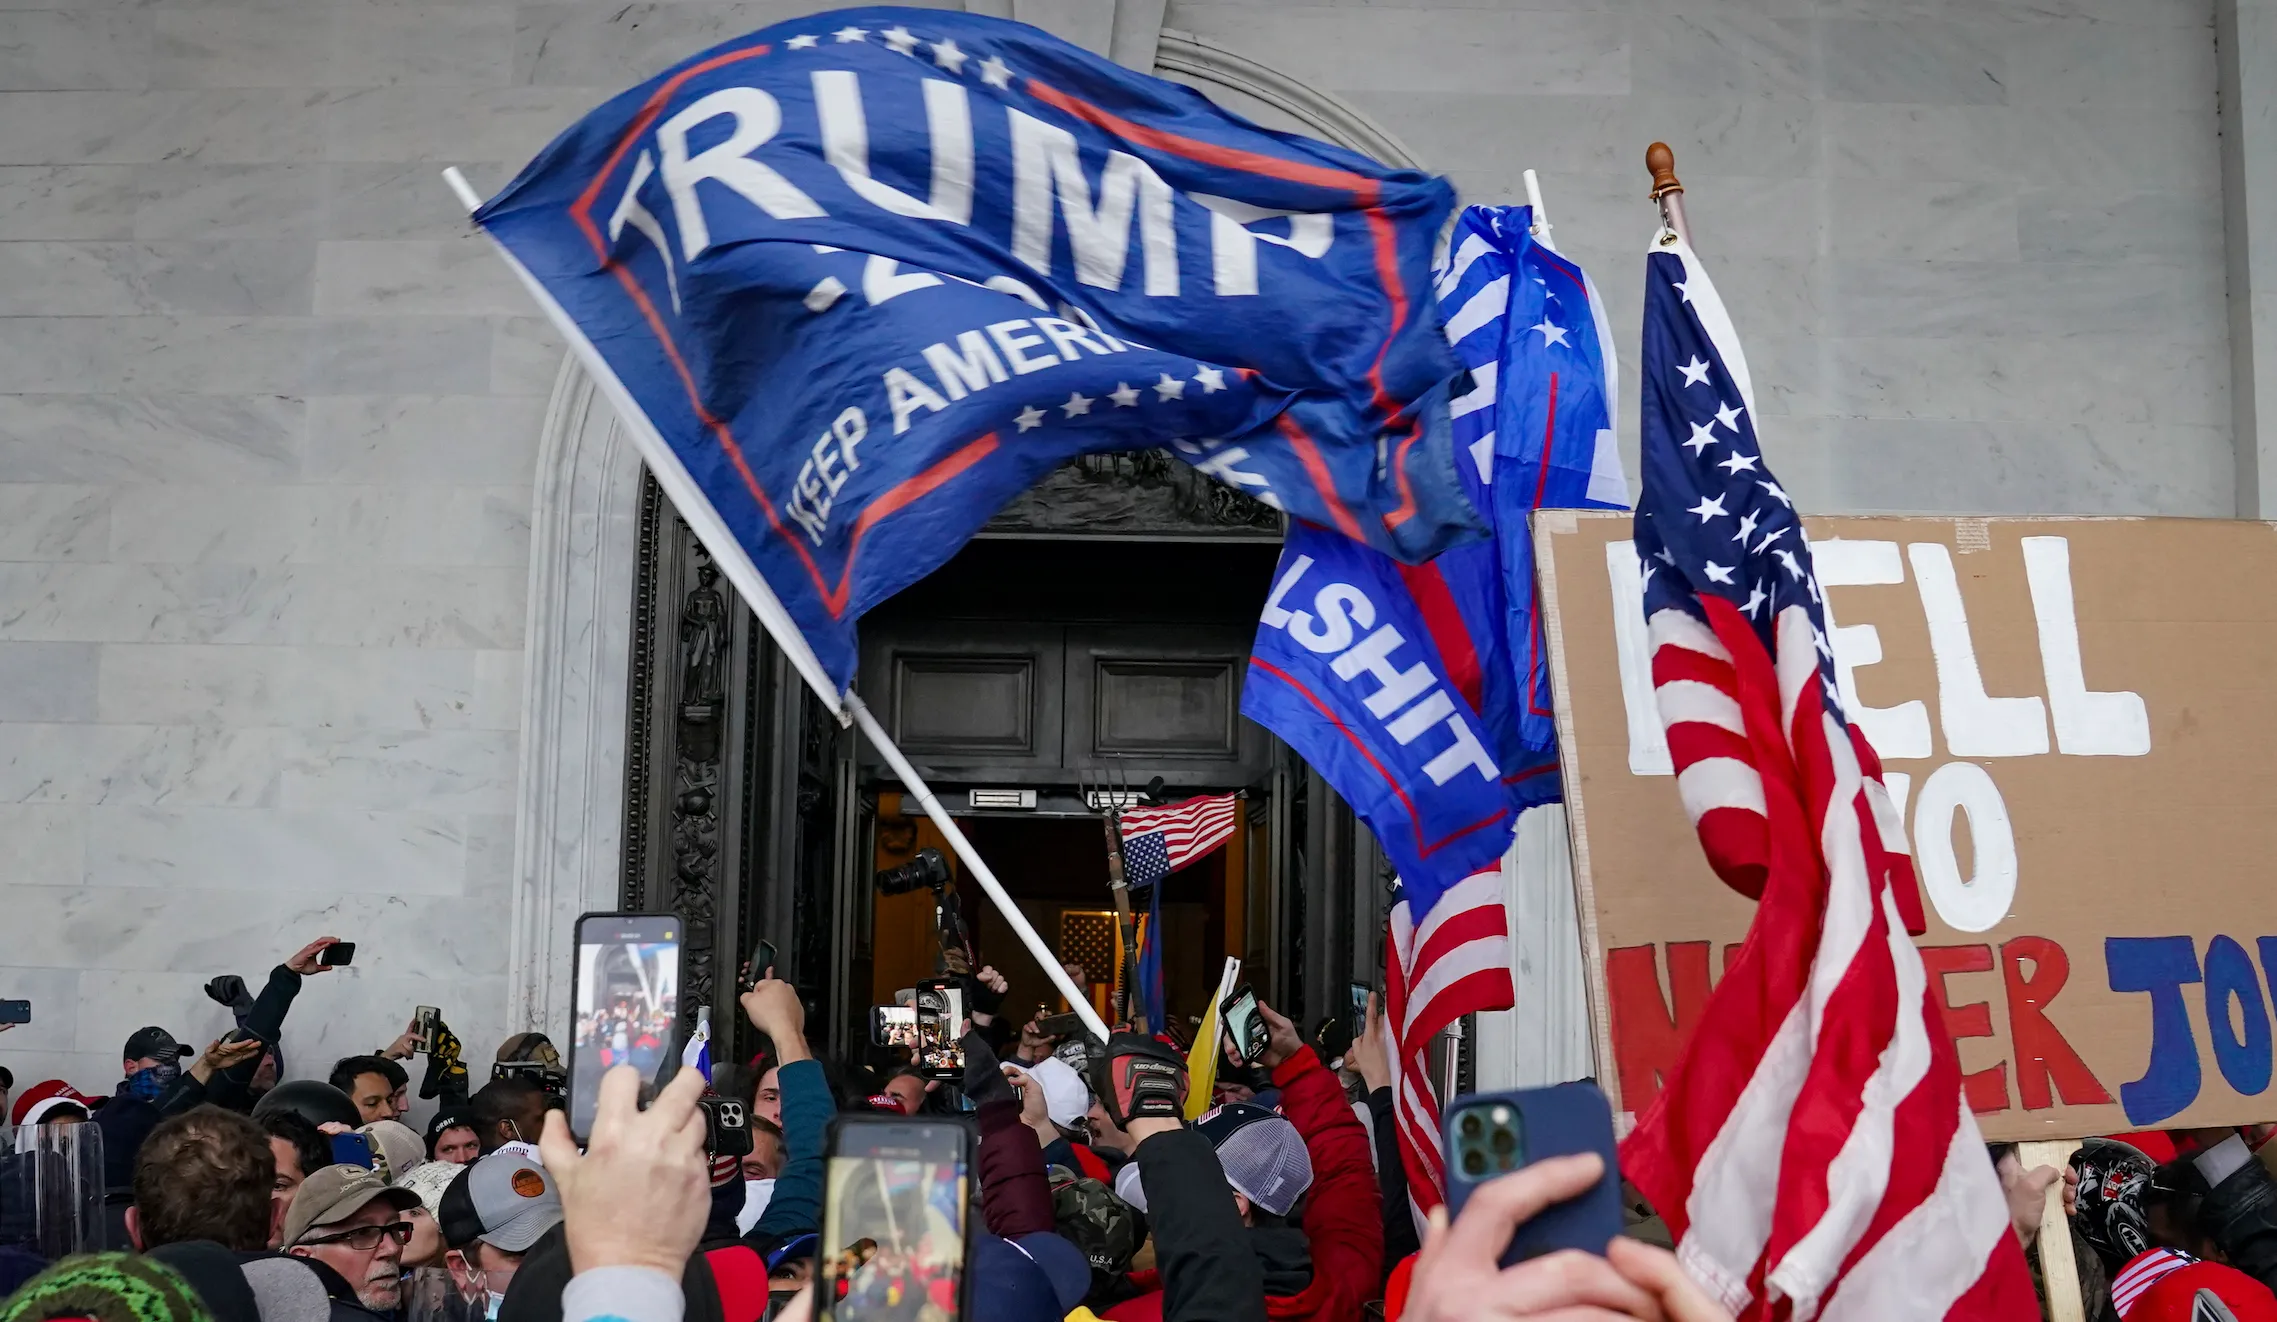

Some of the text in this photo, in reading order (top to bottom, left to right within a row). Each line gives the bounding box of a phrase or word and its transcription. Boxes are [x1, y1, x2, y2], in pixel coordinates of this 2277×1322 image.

[608, 70, 1334, 317] TRUMP
[785, 317, 1155, 547] KEEP AMERI
[435, 1116, 455, 1133] ORBIT
[2104, 934, 2277, 1126] JO
